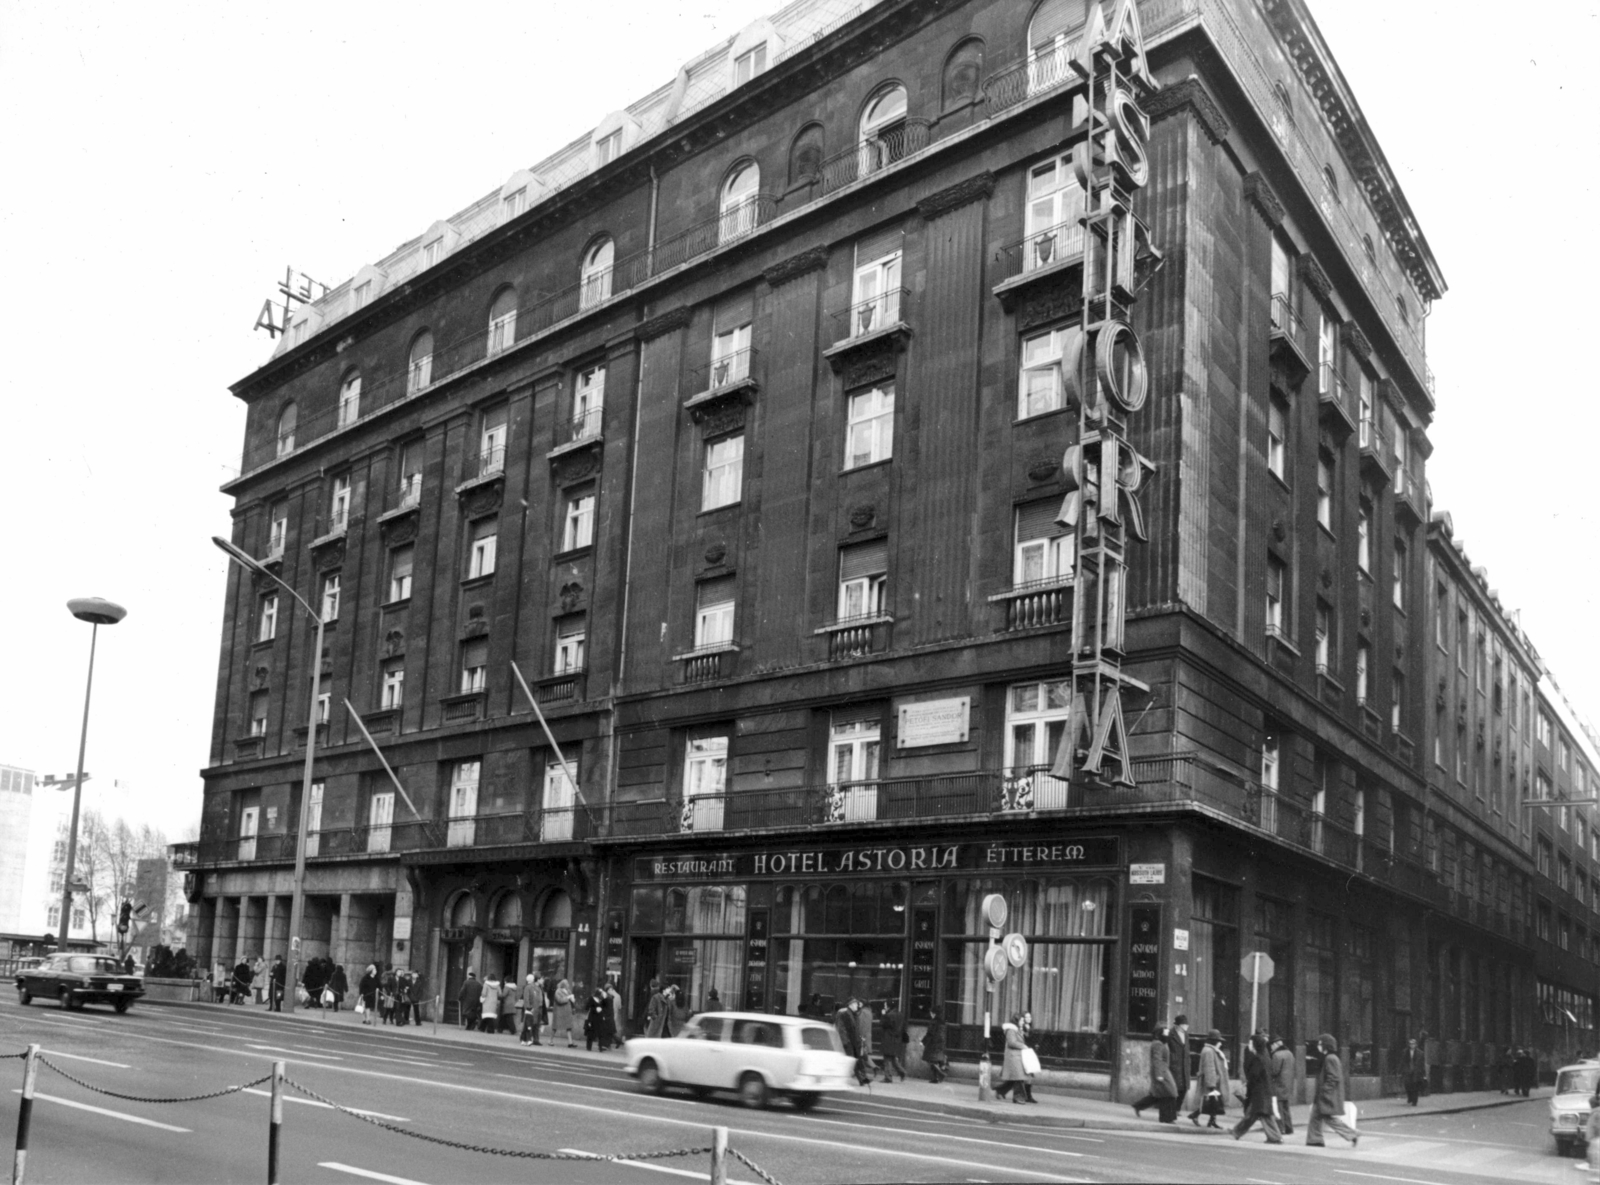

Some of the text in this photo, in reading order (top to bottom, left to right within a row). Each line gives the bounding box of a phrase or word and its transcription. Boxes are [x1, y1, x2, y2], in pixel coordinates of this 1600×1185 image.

[1074, 0, 1162, 789] ASTORIA
[653, 844, 1086, 875] RESTAURANT HOTEL ASTORIA ÉTTEREM
